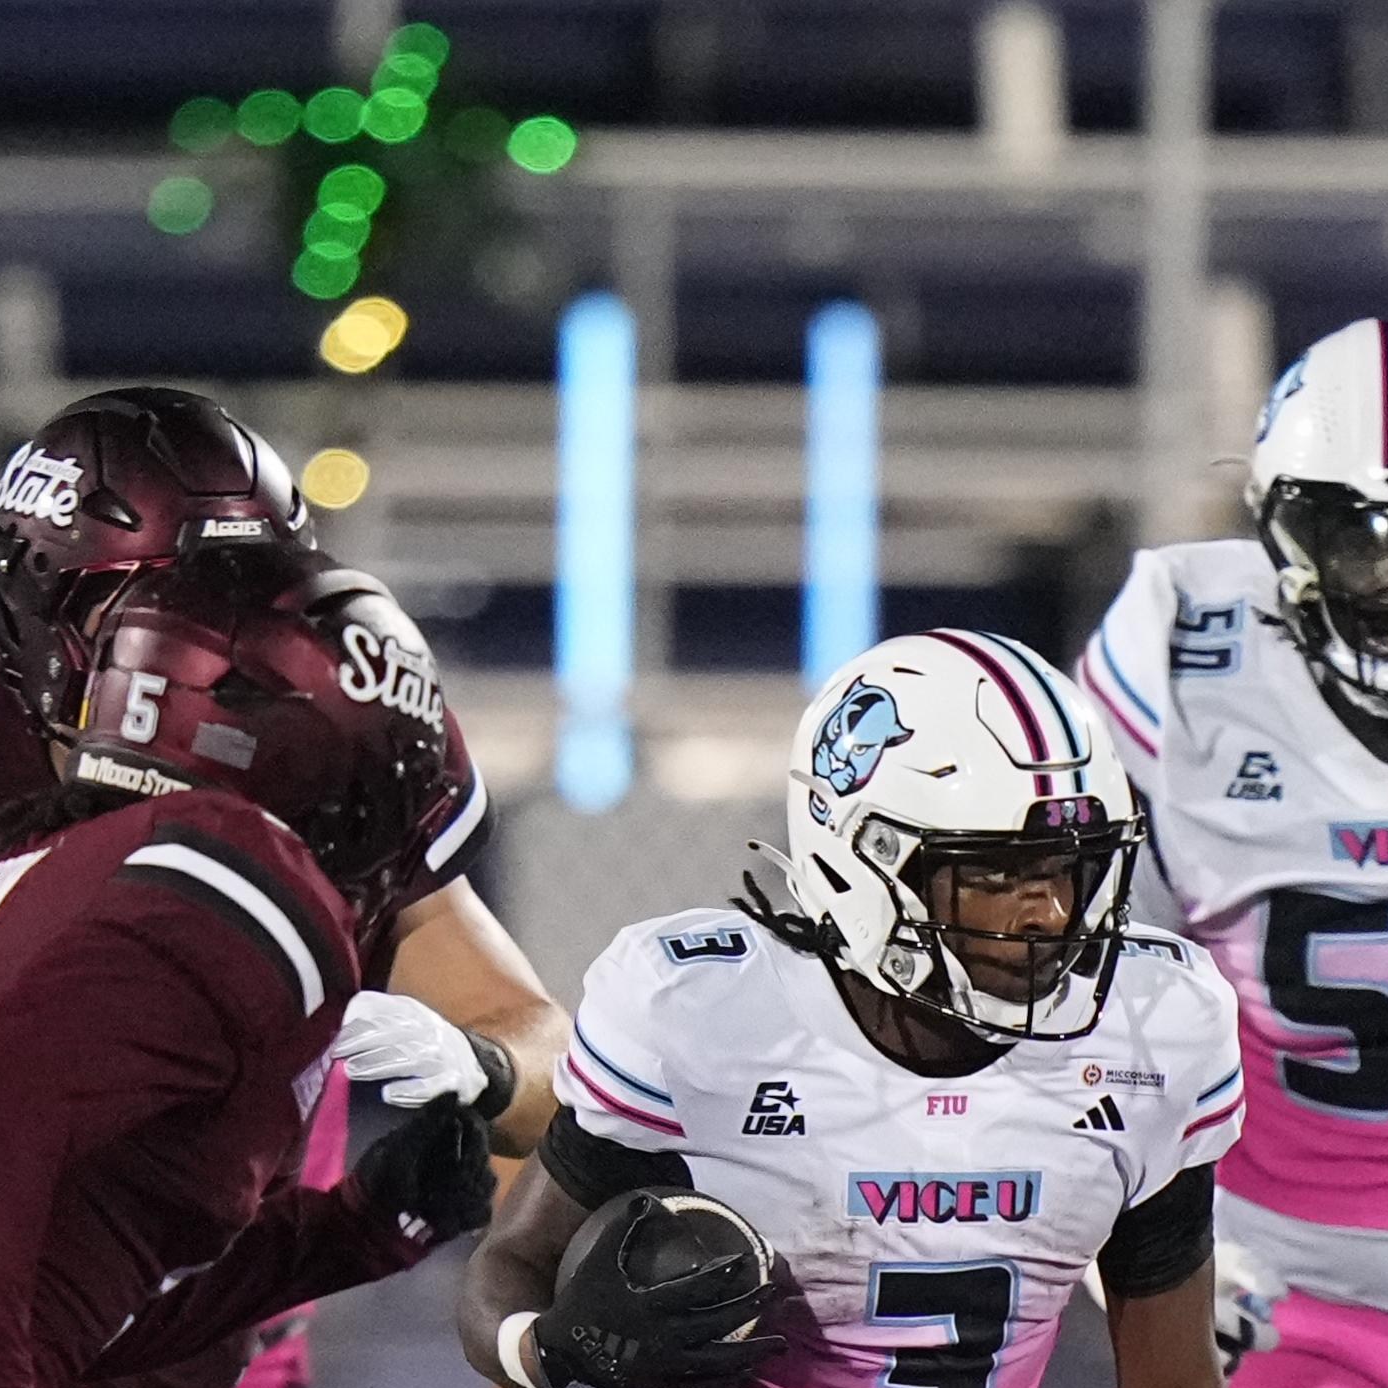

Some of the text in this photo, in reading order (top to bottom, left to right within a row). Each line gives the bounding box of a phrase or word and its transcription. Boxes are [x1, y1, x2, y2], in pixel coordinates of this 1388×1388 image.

[1169, 598, 1245, 678] 50
[120, 671, 168, 744] 5
[1226, 782, 1285, 801] USA
[657, 926, 758, 967] 3
[742, 1114, 806, 1136] USA
[926, 1095, 968, 1116] FIU
[856, 1176, 1034, 1226] VICE U
